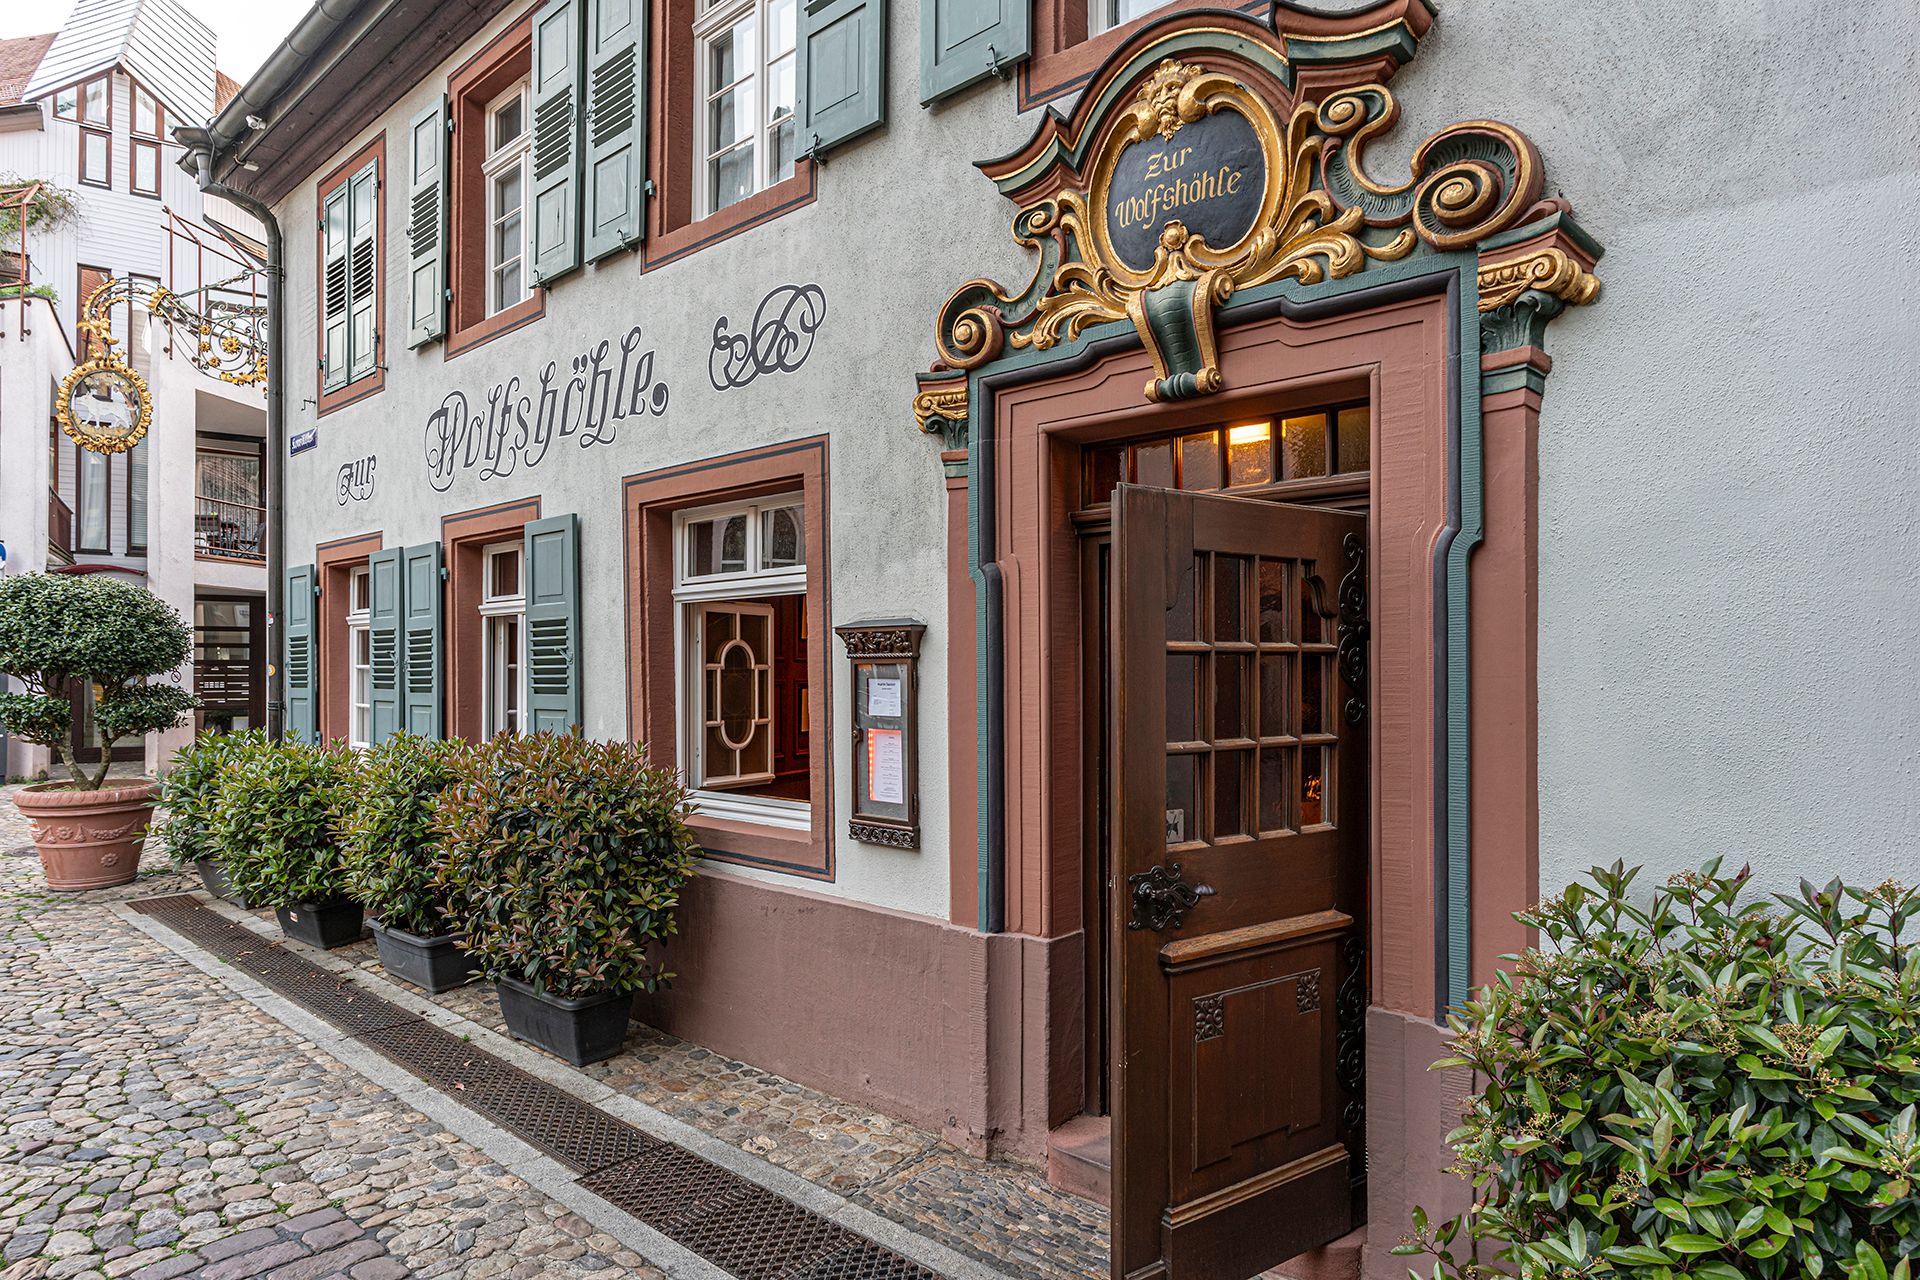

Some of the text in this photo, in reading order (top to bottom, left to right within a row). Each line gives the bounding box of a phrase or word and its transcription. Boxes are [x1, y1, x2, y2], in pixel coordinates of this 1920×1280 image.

[1144, 146, 1193, 181] Zur
[1114, 164, 1242, 230] Wolfshöhle
[336, 453, 377, 506] Zur
